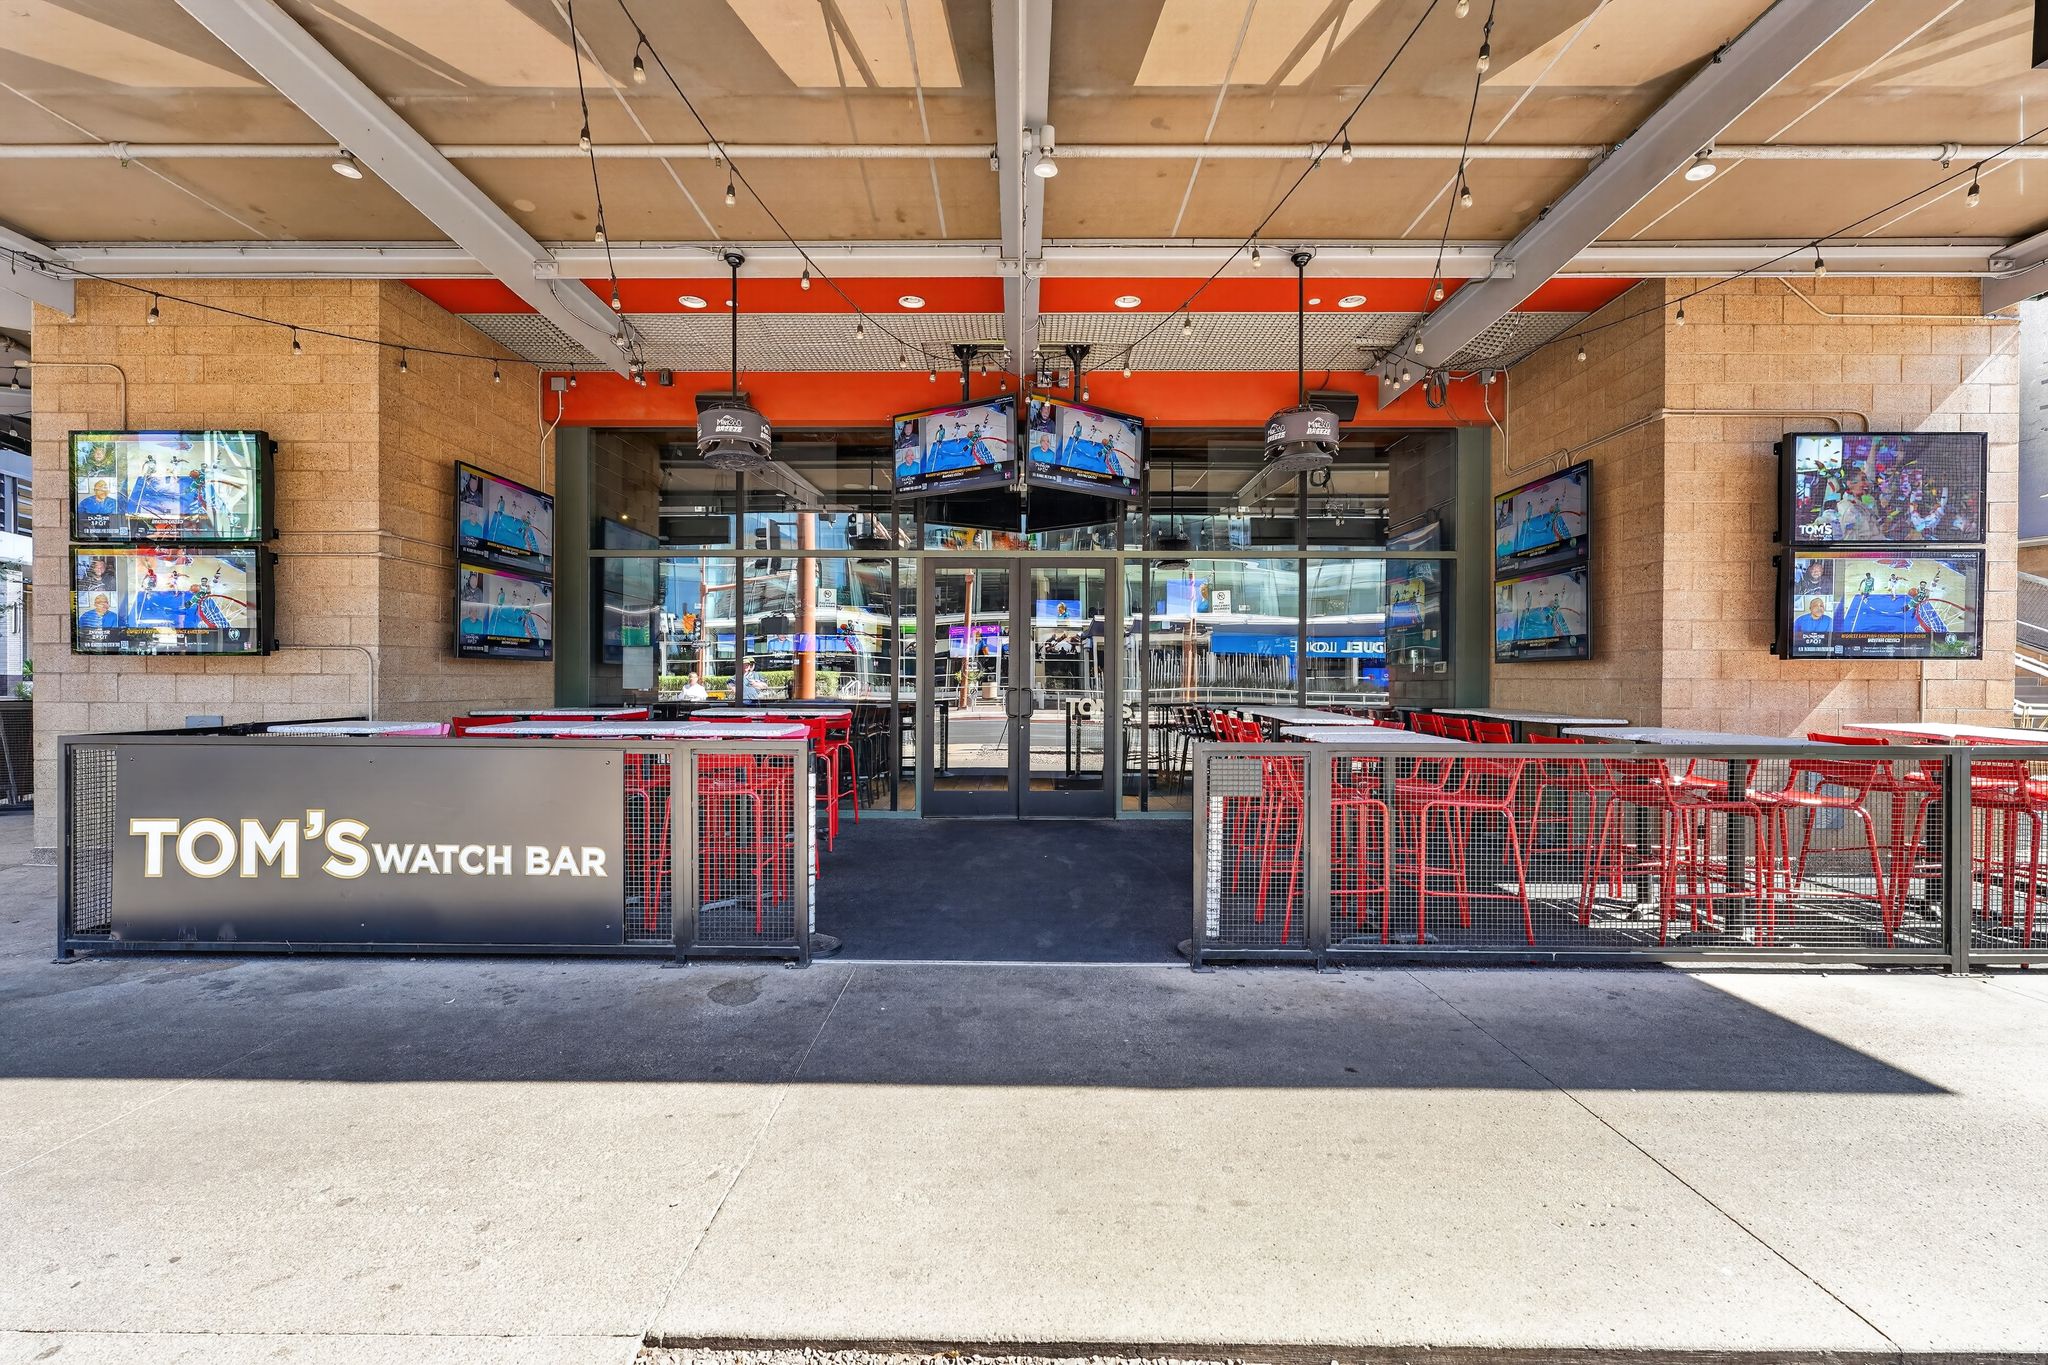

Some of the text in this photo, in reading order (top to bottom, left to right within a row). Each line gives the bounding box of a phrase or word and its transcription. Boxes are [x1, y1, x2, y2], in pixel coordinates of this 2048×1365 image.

[1798, 522, 1832, 535] TOM'S
[129, 809, 608, 878] TOM'S WATCH BAR
